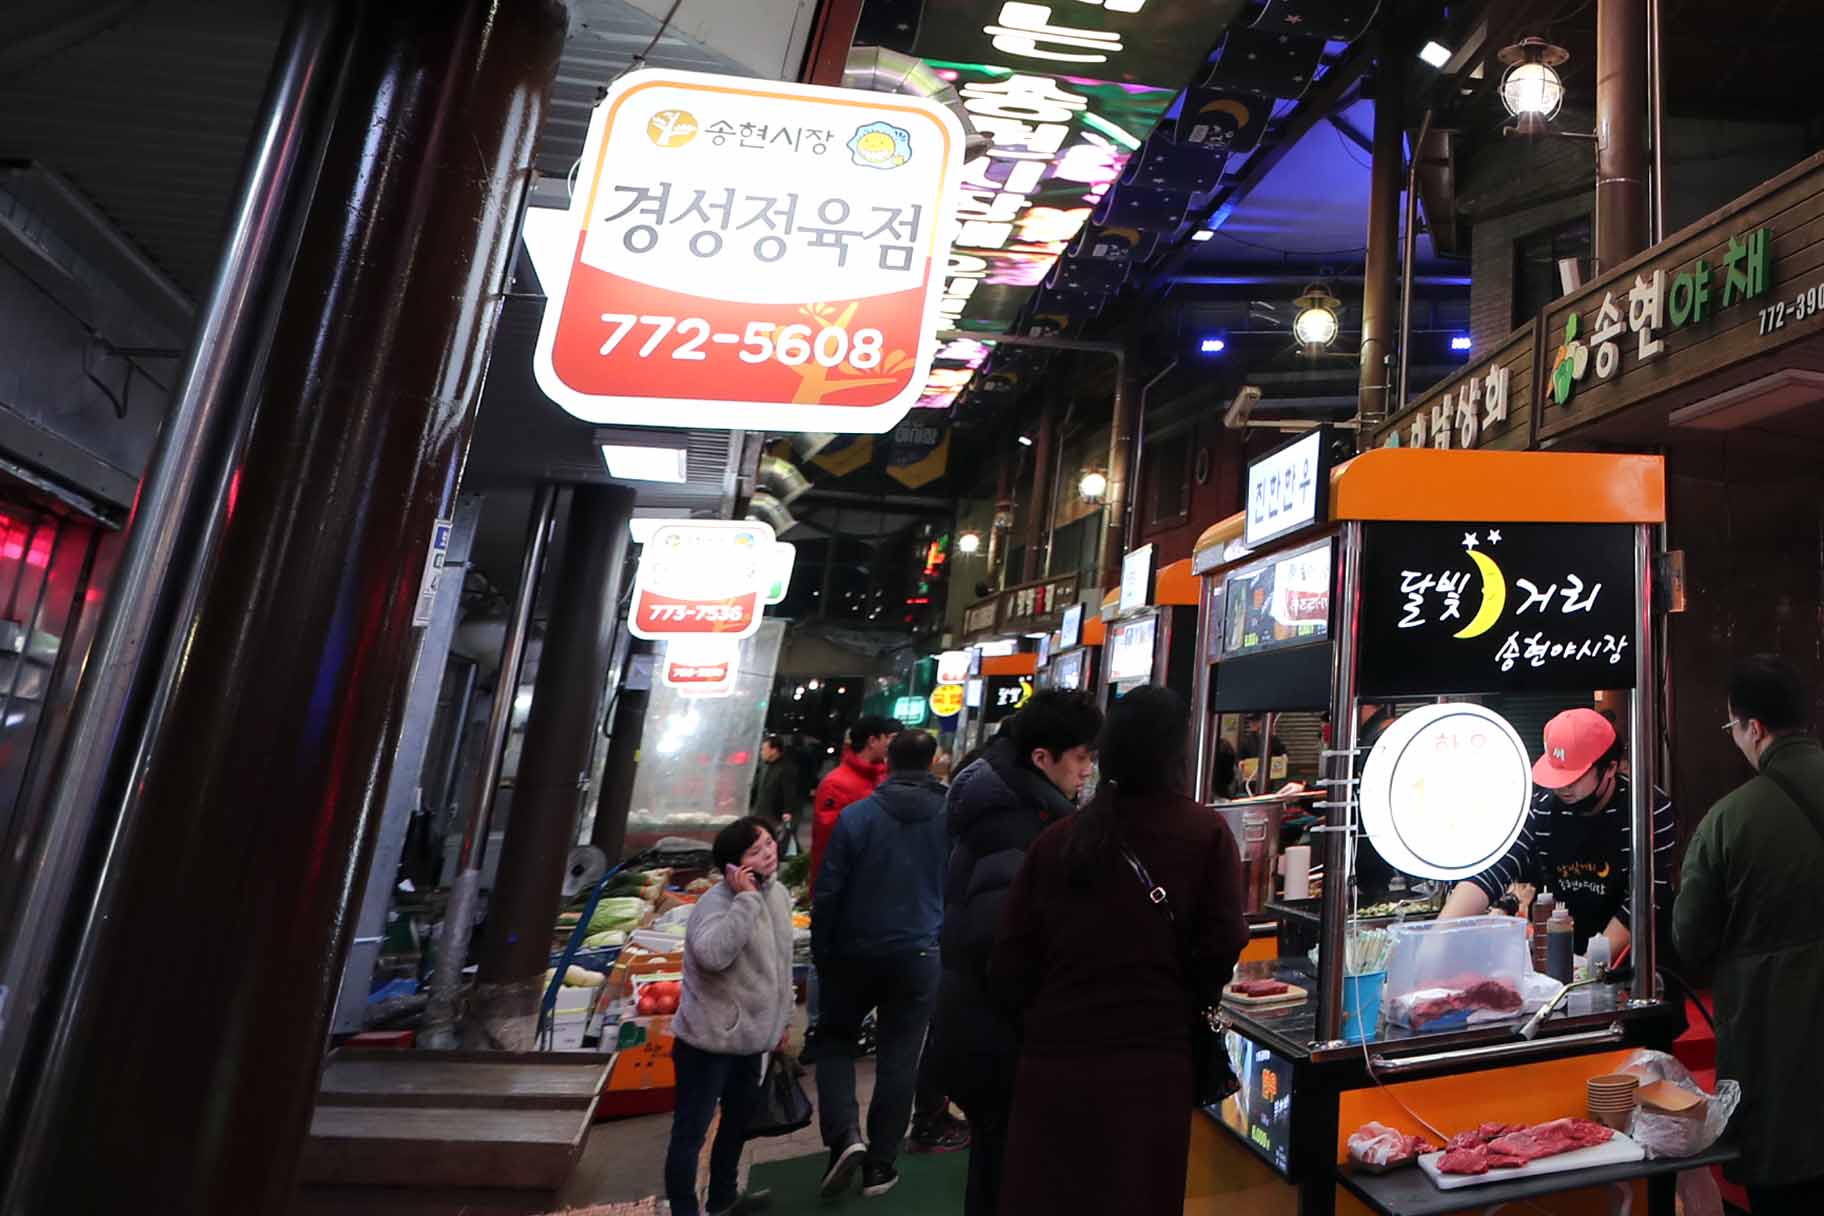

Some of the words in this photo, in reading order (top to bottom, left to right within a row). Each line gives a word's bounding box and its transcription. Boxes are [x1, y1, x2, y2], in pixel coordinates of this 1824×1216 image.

[705, 119, 836, 156] 송현시장
[604, 181, 923, 272] 경성정육점
[599, 313, 884, 370] 772-5608
[1397, 569, 1472, 629] 달빛
[1515, 573, 1603, 616] 거리
[1494, 631, 1629, 672] 송현야시장
